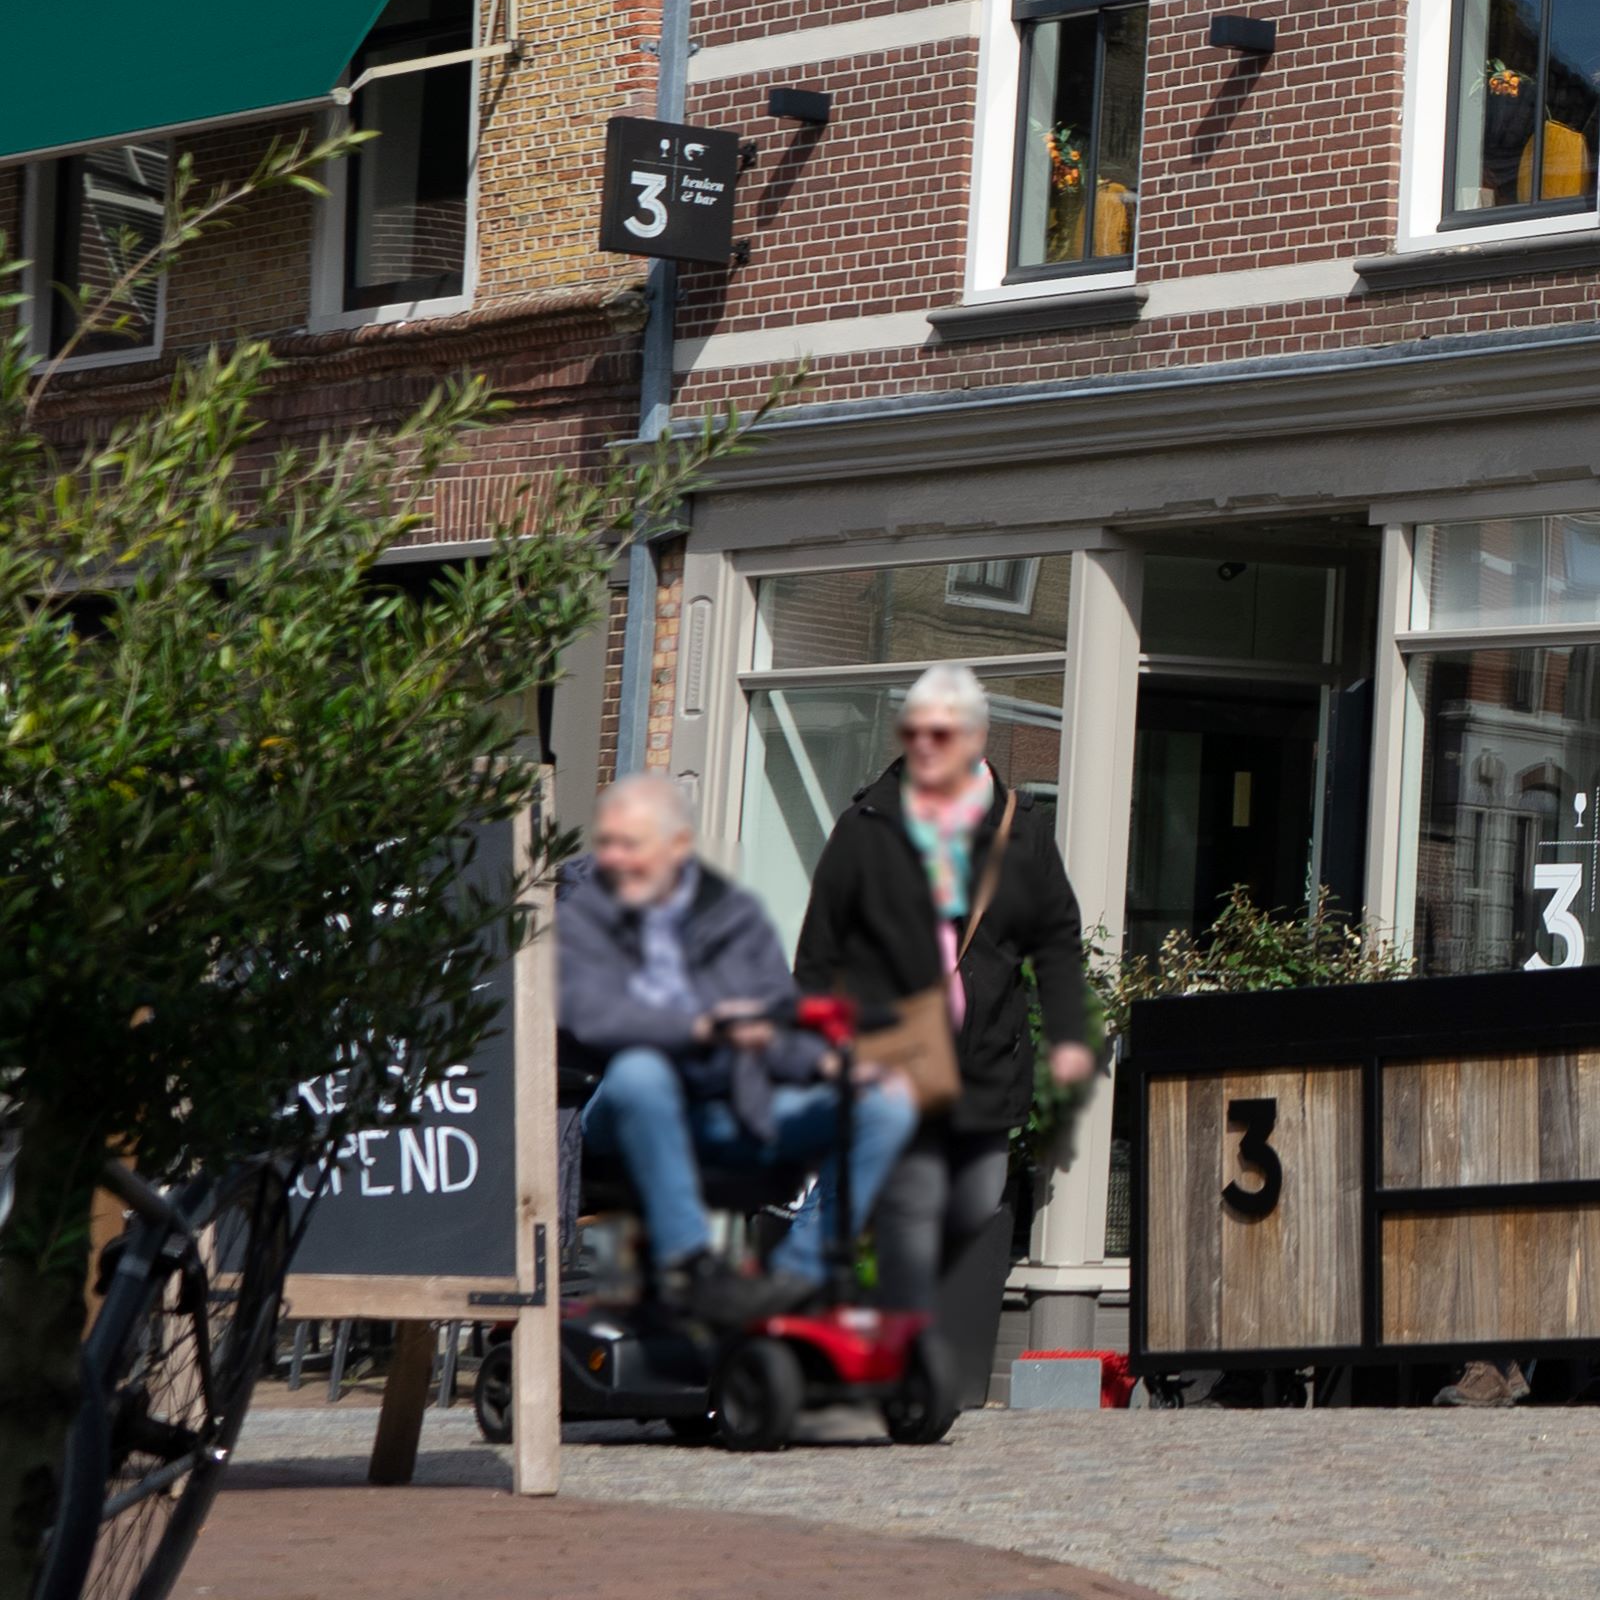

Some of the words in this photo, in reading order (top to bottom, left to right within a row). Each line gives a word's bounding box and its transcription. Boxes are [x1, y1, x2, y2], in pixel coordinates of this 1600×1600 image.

[623, 171, 668, 238] 3
[681, 174, 725, 192] keuken
[694, 191, 718, 206] bar
[1523, 863, 1585, 971] 3
[1221, 1097, 1283, 1220] 3
